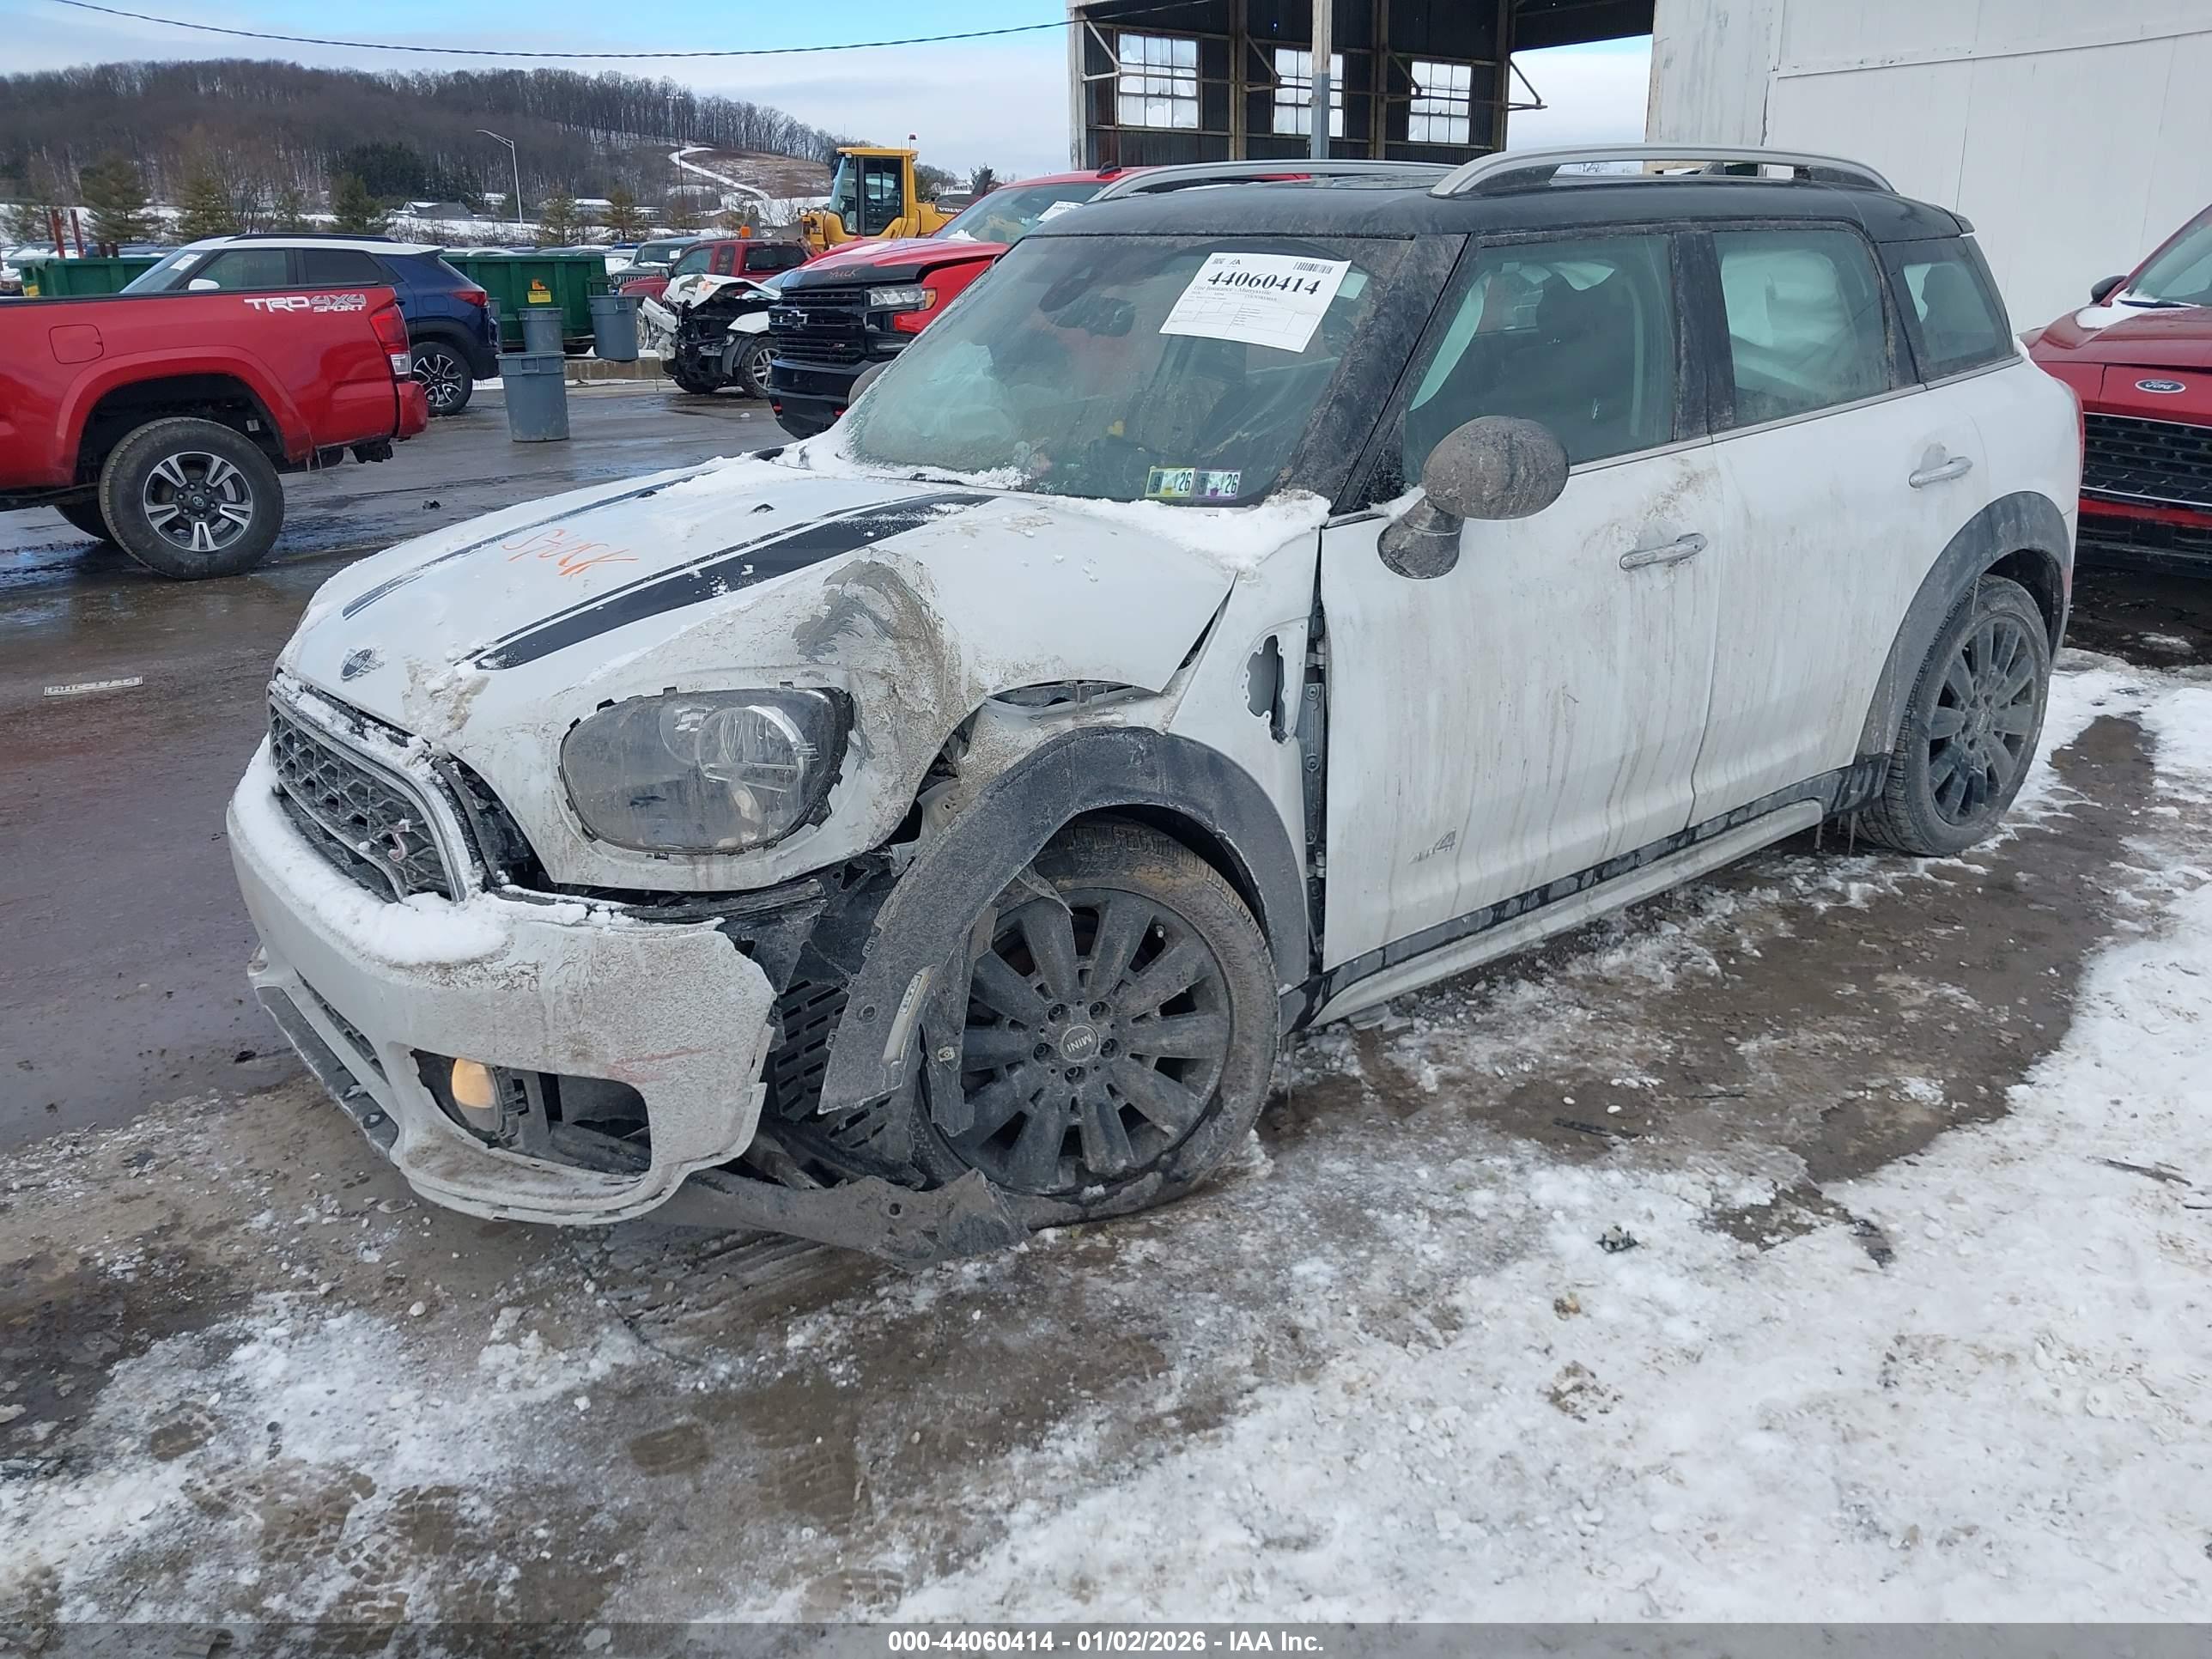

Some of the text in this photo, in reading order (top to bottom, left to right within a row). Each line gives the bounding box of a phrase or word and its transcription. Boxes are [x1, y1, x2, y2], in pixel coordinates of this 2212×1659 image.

[1207, 270, 1322, 295] 44060414
[244, 296, 310, 313] TRD
[1178, 472, 1192, 492] 26
[1225, 474, 1238, 494] 26
[1066, 1034, 1091, 1053] MINI
